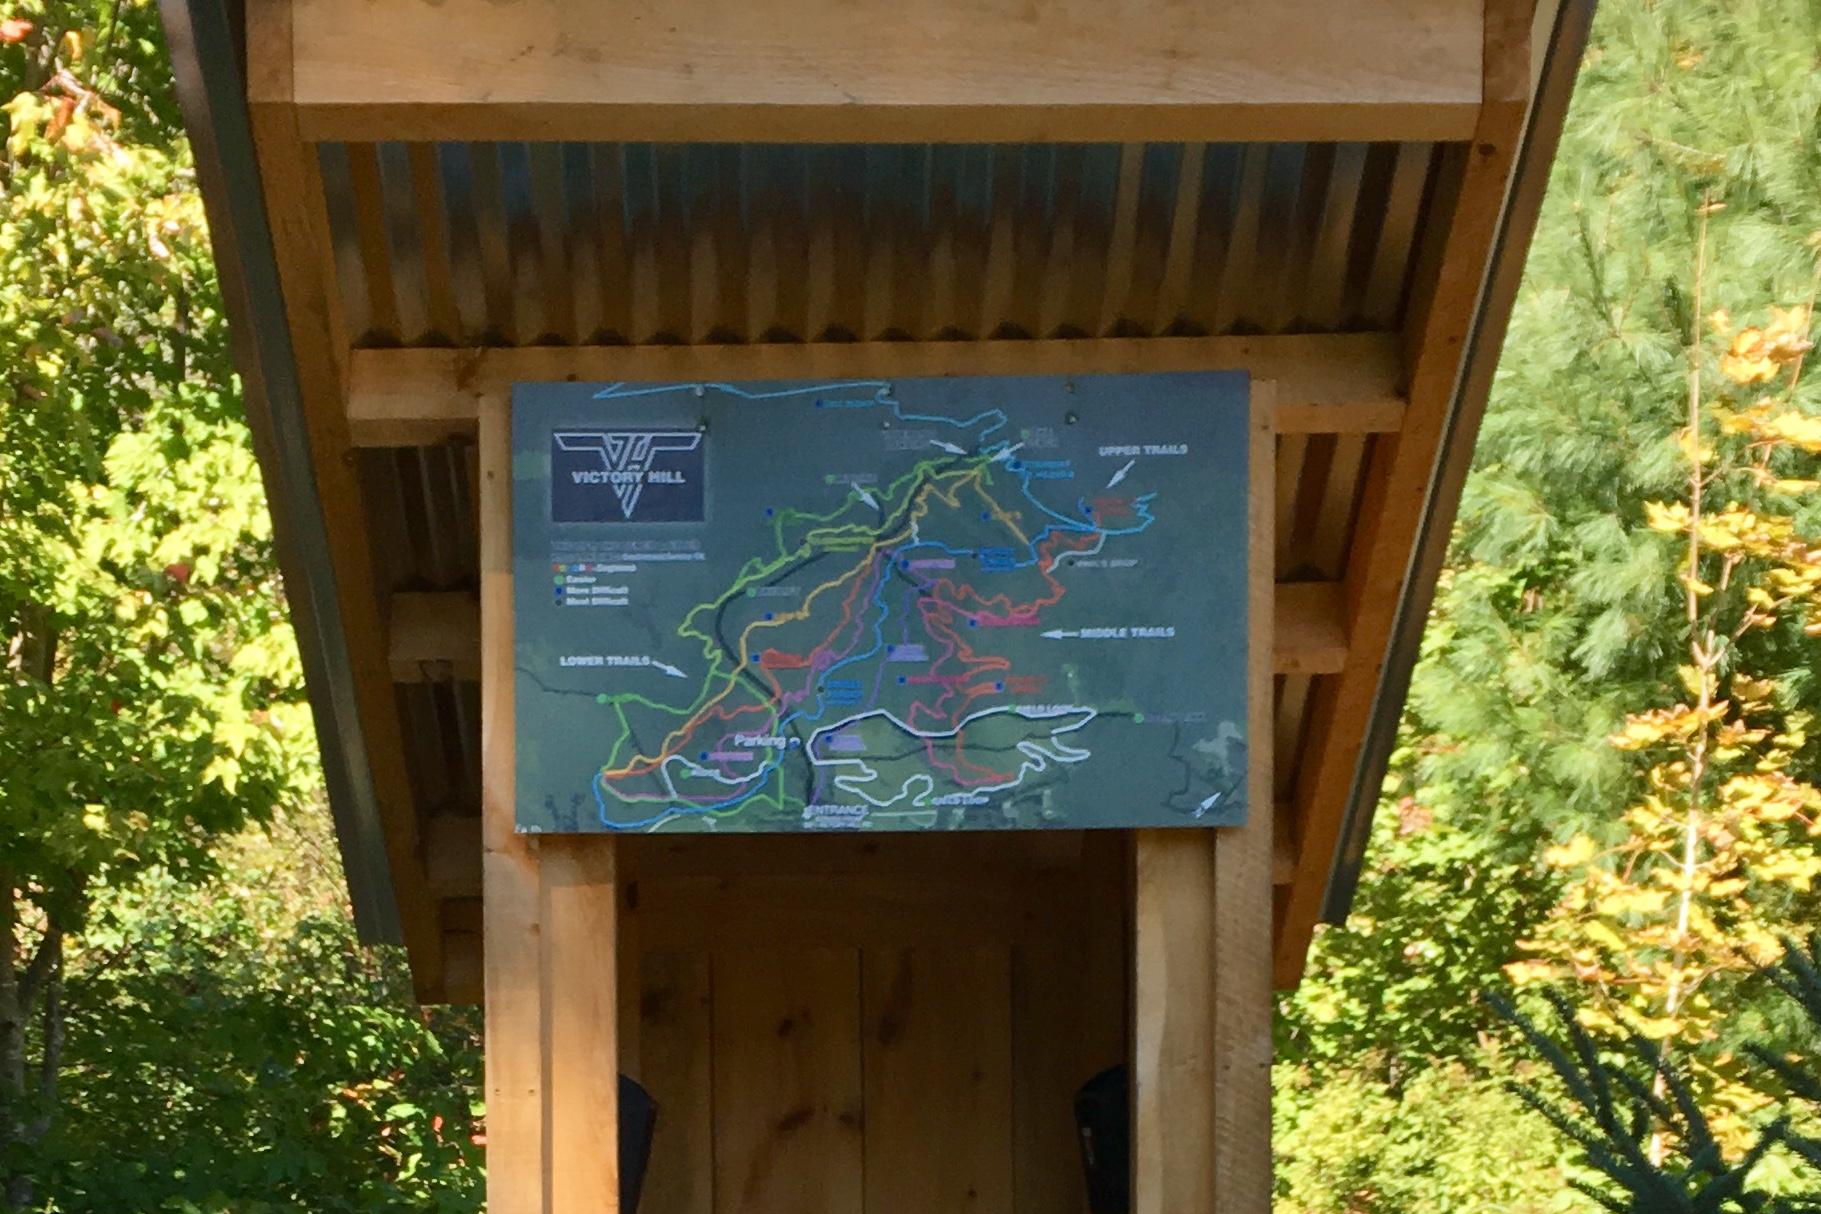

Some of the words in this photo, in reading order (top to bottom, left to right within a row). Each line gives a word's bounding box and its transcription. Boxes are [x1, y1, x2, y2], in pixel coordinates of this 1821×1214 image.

[1099, 445, 1141, 456] UPPER
[1143, 444, 1188, 455] TRAILS
[572, 471, 644, 484] VICTORY
[648, 471, 686, 484] HILL
[1080, 627, 1127, 638] MIDDLE
[1131, 626, 1175, 637] TRAILS
[560, 656, 604, 666] LOWER
[606, 656, 650, 666] TRAILS
[735, 734, 786, 748] Parking
[808, 805, 869, 816] ENTRANCE
